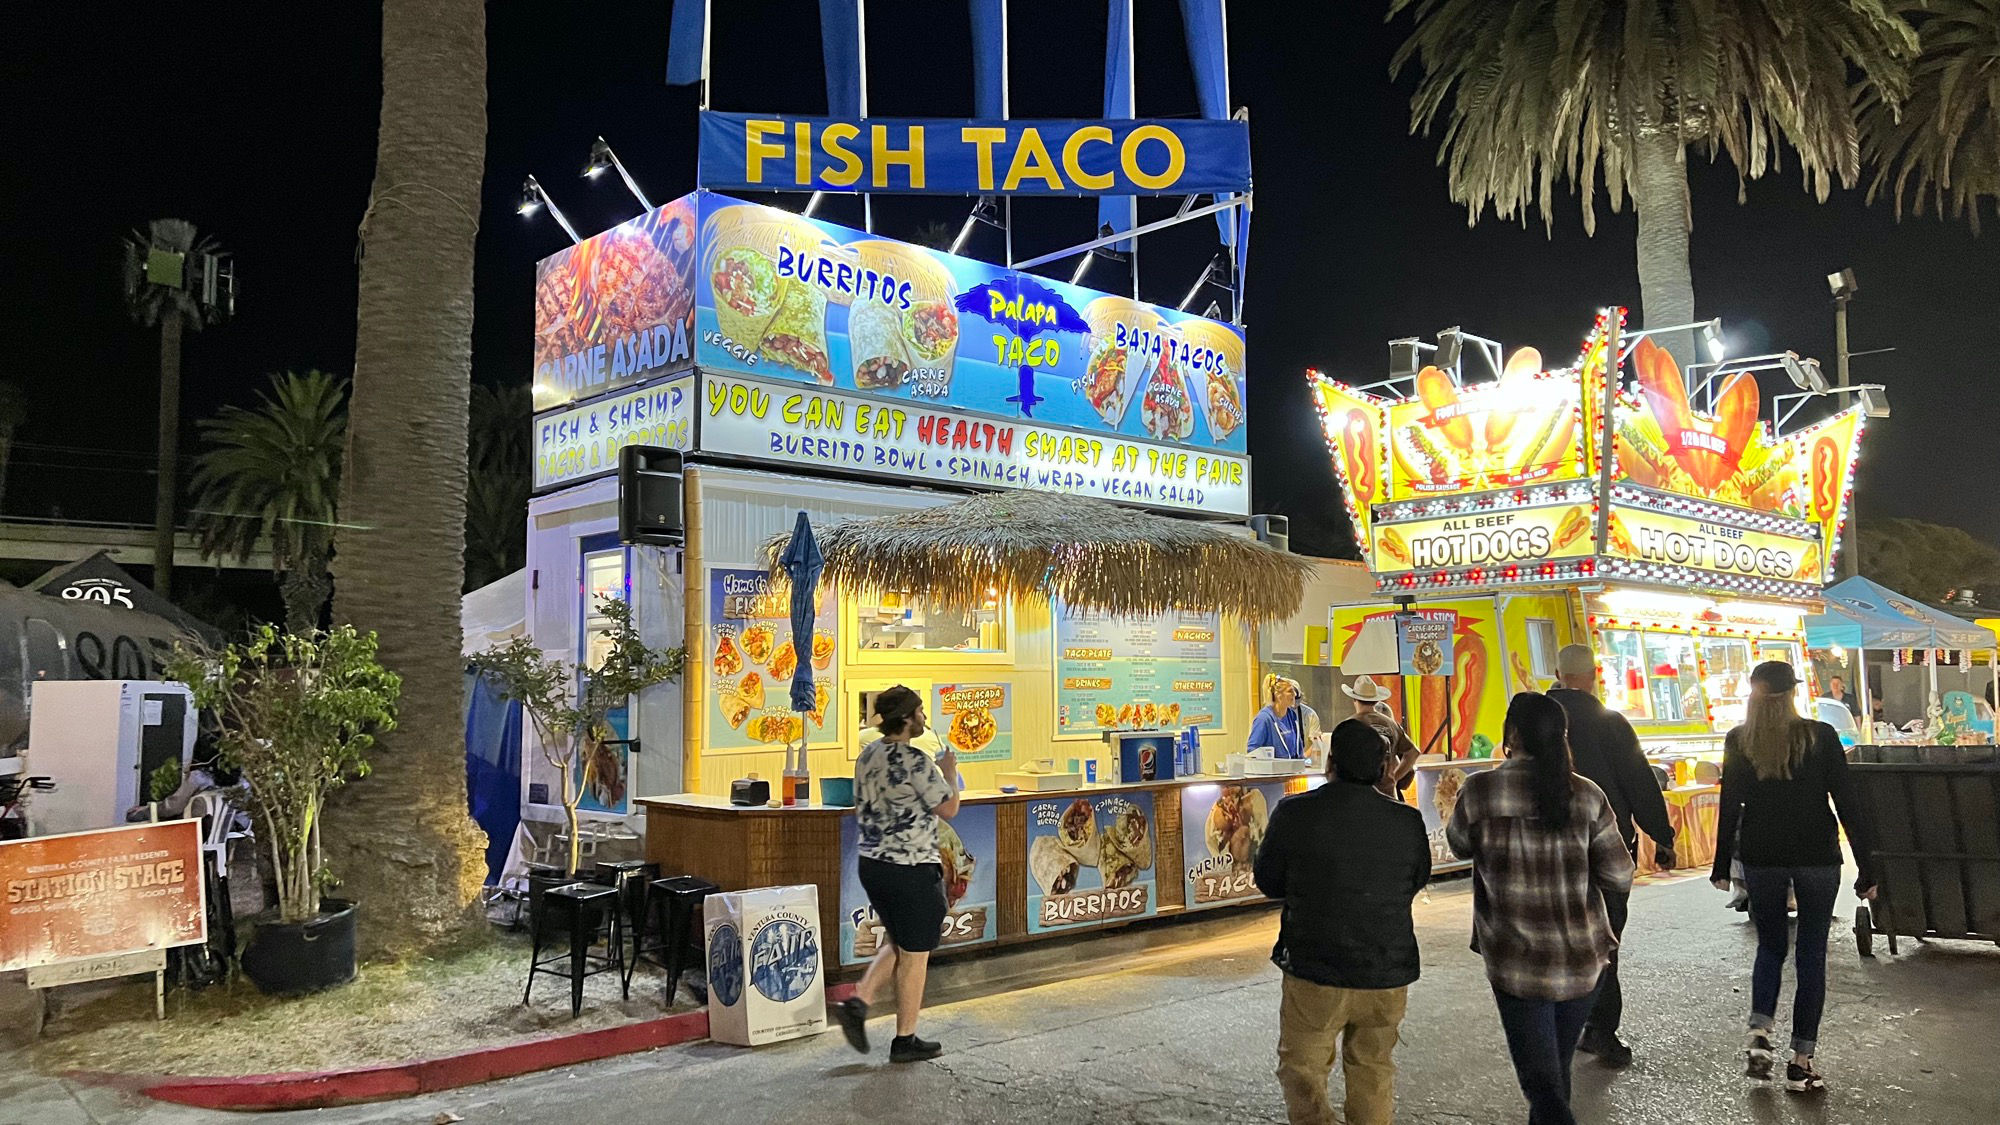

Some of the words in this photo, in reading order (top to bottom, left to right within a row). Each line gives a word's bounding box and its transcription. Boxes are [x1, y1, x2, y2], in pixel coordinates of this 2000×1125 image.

[746, 119, 925, 189] FISH
[962, 125, 1186, 190] TACO
[778, 246, 912, 310] BURRITOS
[988, 290, 1057, 325] Palapa
[539, 344, 607, 390] CARNE
[610, 318, 689, 379] ASADA
[703, 329, 759, 365] VEGGIE
[992, 334, 1060, 368] TACO
[1115, 323, 1162, 358] BAJA
[1169, 338, 1225, 376] TACOS
[902, 368, 945, 383] CARNE
[911, 382, 949, 398] ASADA
[1071, 373, 1096, 394] FISH
[1153, 382, 1183, 398] CARNE
[543, 416, 581, 447] FISH
[589, 412, 600, 435] &
[608, 387, 684, 430] SHRIMP
[1219, 398, 1244, 424] SHRIMP
[708, 380, 769, 418] YOU
[782, 394, 845, 430] CAN
[855, 404, 906, 440] EAT
[917, 415, 1015, 456] HEALTH
[1024, 431, 1103, 467] SMART
[1112, 445, 1139, 472] AT
[1148, 449, 1188, 478] THE
[1195, 457, 1243, 486] FAIR
[538, 445, 585, 483] TACOS
[589, 441, 600, 468] &
[770, 432, 865, 463] BURRITO
[874, 446, 928, 470] BOWL
[948, 456, 1030, 483] SPINACH
[1037, 469, 1085, 488] WRAP
[1102, 478, 1152, 498] VEGAN
[1160, 485, 1205, 505] SALAD
[1443, 518, 1471, 532] ALL
[1476, 514, 1515, 528] BEEF
[1699, 523, 1717, 536] ALL
[1720, 527, 1744, 540] BEEF
[1412, 535, 1466, 569] HOT
[1470, 526, 1550, 564] DOGS
[1640, 527, 1706, 566] HOT
[1713, 541, 1793, 578] DOGS
[723, 574, 754, 595] Home
[735, 596, 766, 617] FISH
[1177, 632, 1211, 640] NACHOS
[1065, 649, 1087, 658] TACO
[1089, 649, 1112, 658] PLATE
[944, 690, 972, 702] CARNE
[974, 688, 1001, 699] ASADA
[1075, 678, 1101, 688] DRINKS
[1174, 681, 1192, 690] OTHER
[956, 700, 990, 710] NACHOS
[1032, 803, 1058, 814] CARNE
[1095, 797, 1131, 812] SPINACH
[7, 870, 106, 904] STATION
[114, 859, 186, 890] STAGE
[1188, 852, 1234, 884] SHRIMP
[1044, 889, 1142, 921] BURRITOS
[748, 915, 775, 941] VENTURA
[777, 911, 810, 925] COUNTY
[752, 926, 818, 979] FAIR
